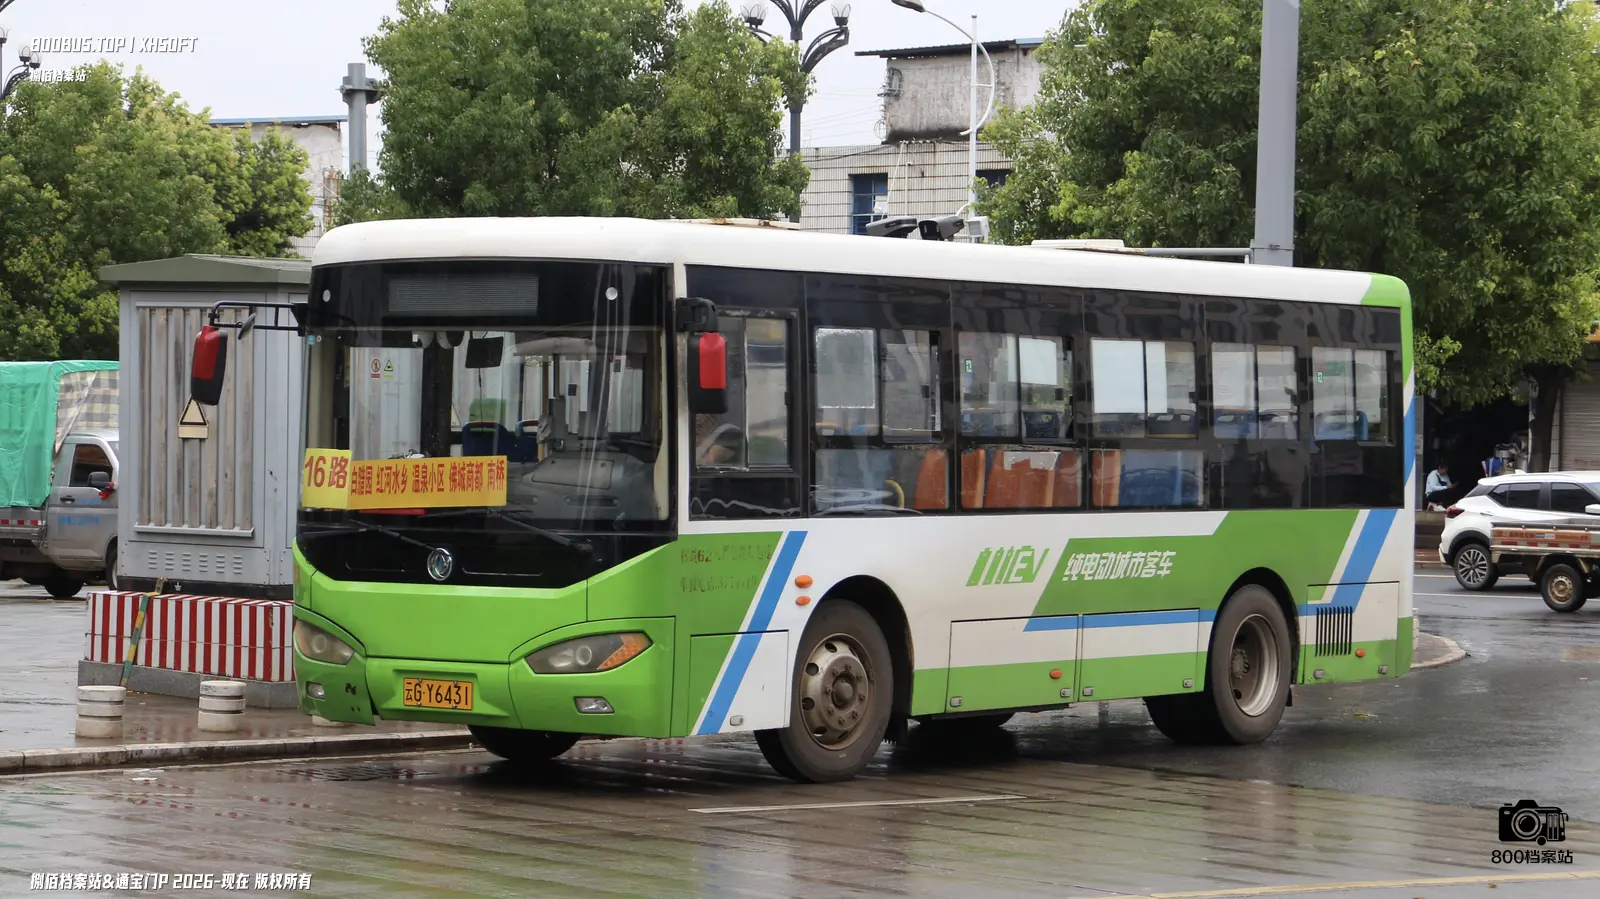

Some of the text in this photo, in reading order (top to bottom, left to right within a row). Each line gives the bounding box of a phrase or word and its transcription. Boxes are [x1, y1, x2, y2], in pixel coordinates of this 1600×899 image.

[304, 455, 349, 489] 16路
[376, 463, 408, 495] 红河水乡
[412, 462, 445, 494] 温泉小区
[449, 460, 484, 492] 佛城商都
[1061, 550, 1177, 582] 纯电动城市客车
